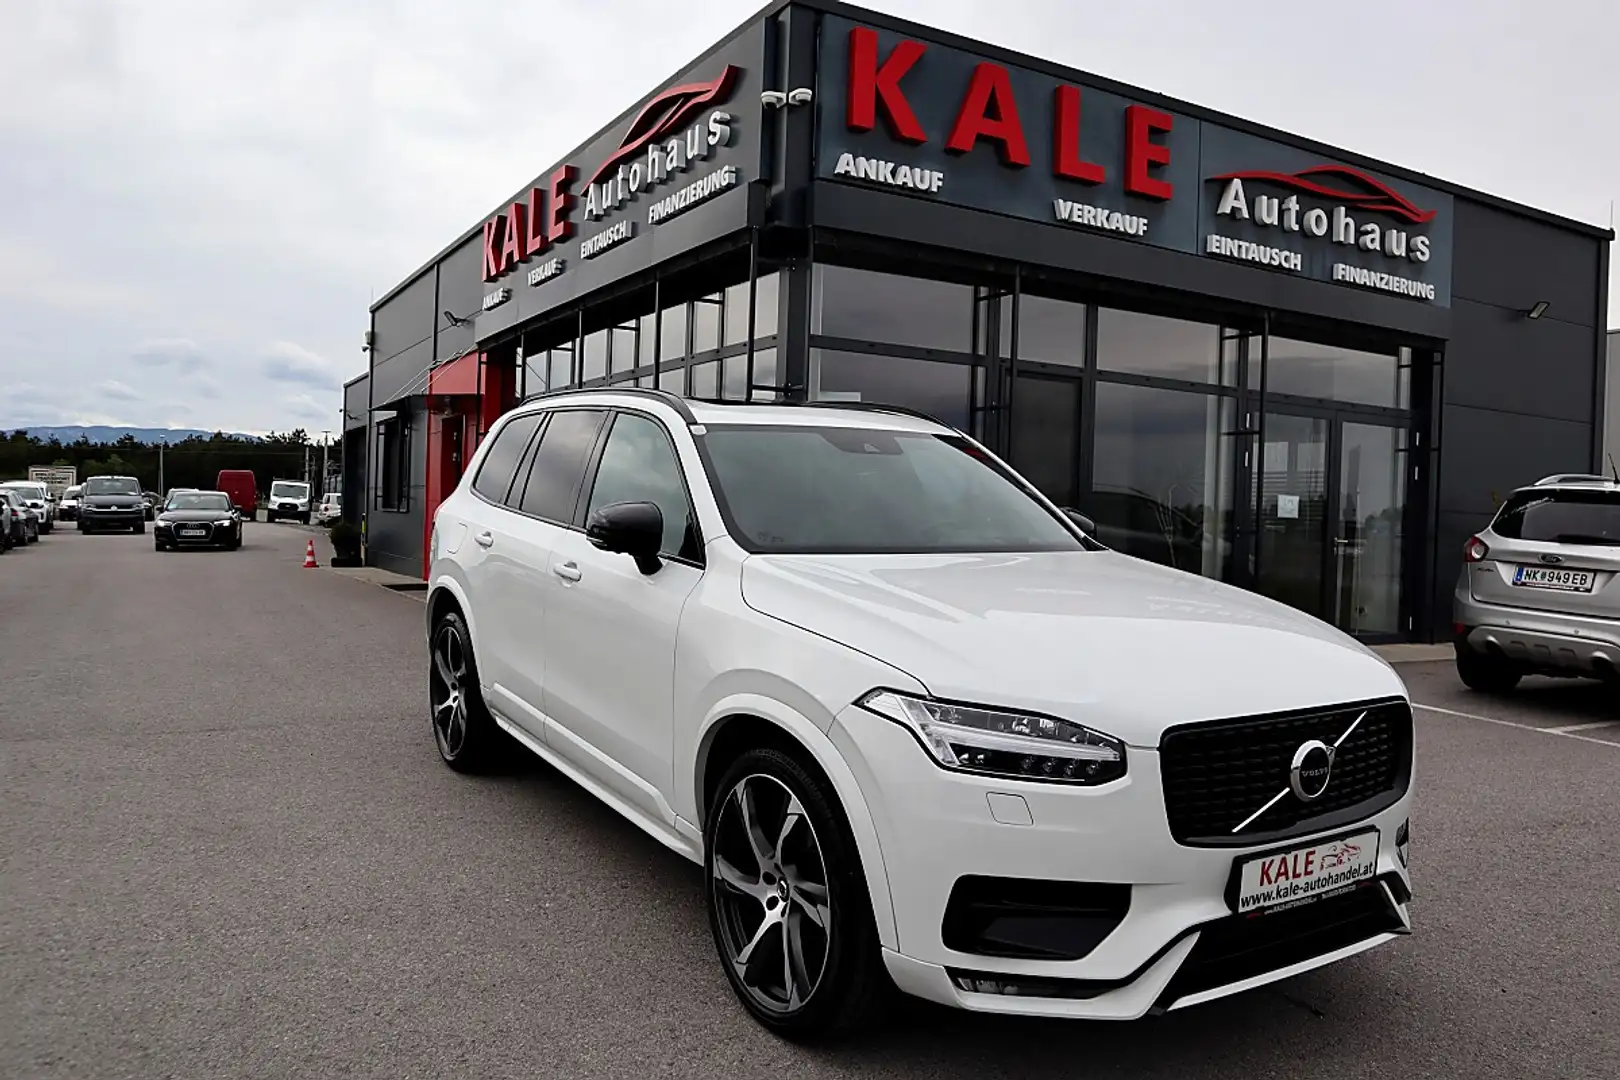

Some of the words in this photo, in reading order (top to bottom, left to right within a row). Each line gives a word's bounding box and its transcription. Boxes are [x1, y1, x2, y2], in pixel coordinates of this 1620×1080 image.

[847, 26, 1173, 200] KALE
[584, 110, 732, 220] Autohaus
[834, 152, 944, 193] ANKAUF
[648, 164, 736, 224] FINANZIERUNG
[482, 165, 578, 282] KALE
[580, 219, 633, 259] EINTAUSCH
[1053, 198, 1149, 237] VERKAUF
[1216, 178, 1431, 263] Autohaus
[1206, 234, 1302, 272] EINTAUSCH
[1332, 262, 1436, 301] FINANZIERUNG
[1240, 861, 1374, 908] www.kale-autohandel.at
[1259, 849, 1316, 887] KALE
